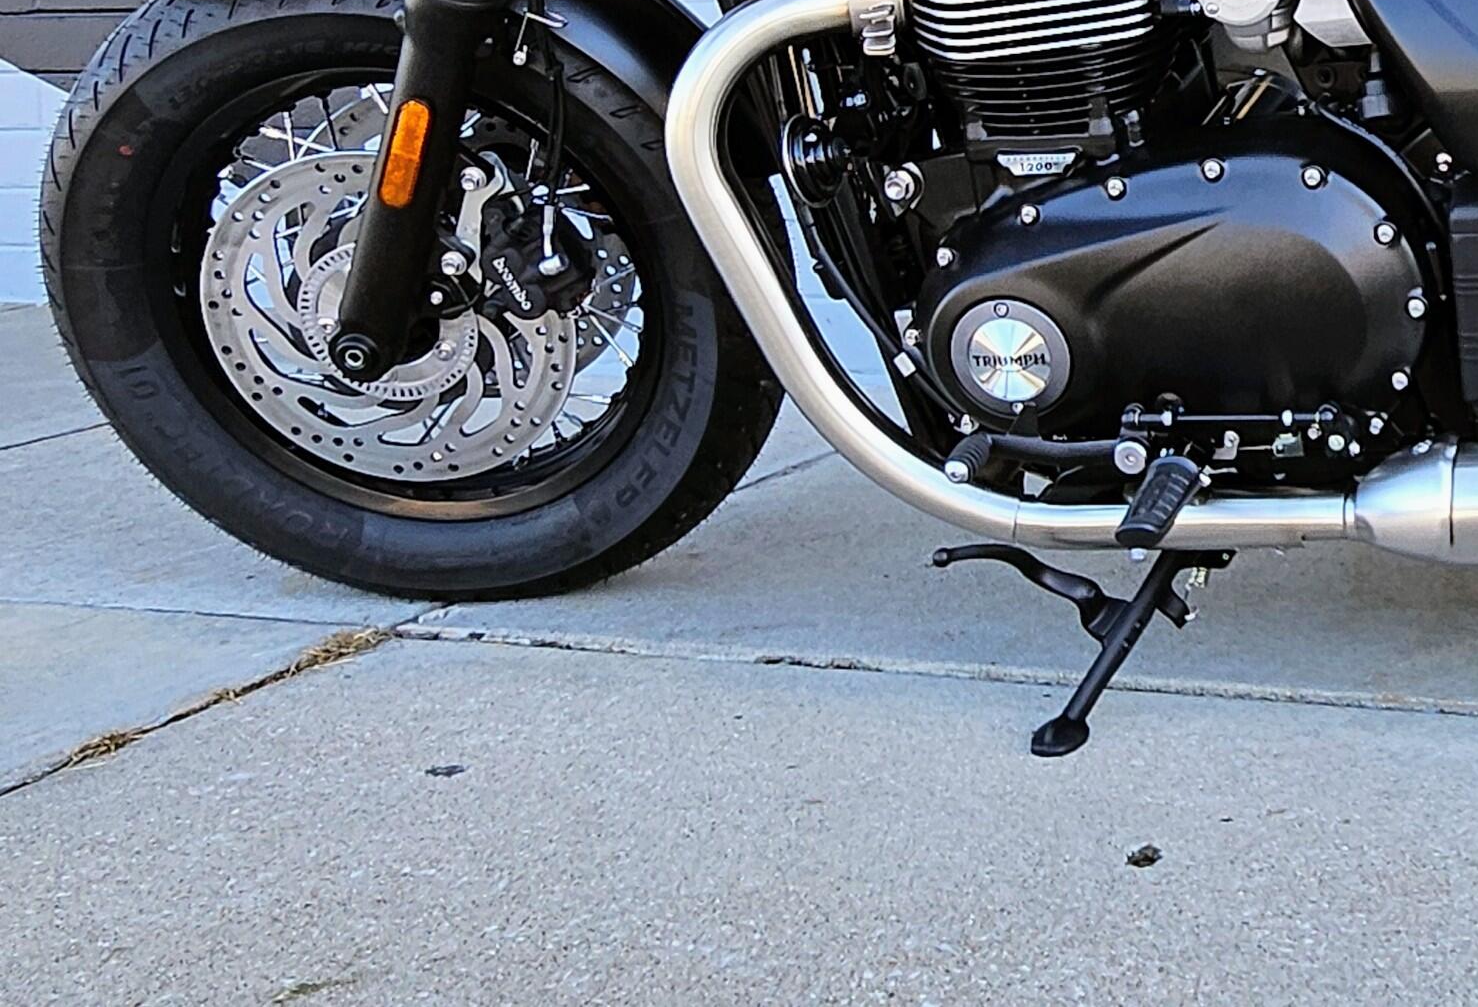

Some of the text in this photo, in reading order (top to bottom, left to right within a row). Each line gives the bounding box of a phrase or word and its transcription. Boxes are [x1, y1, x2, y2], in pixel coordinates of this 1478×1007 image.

[1020, 162, 1053, 172] 1200
[492, 256, 532, 311] brembo
[972, 353, 1046, 370] TRIUMPH
